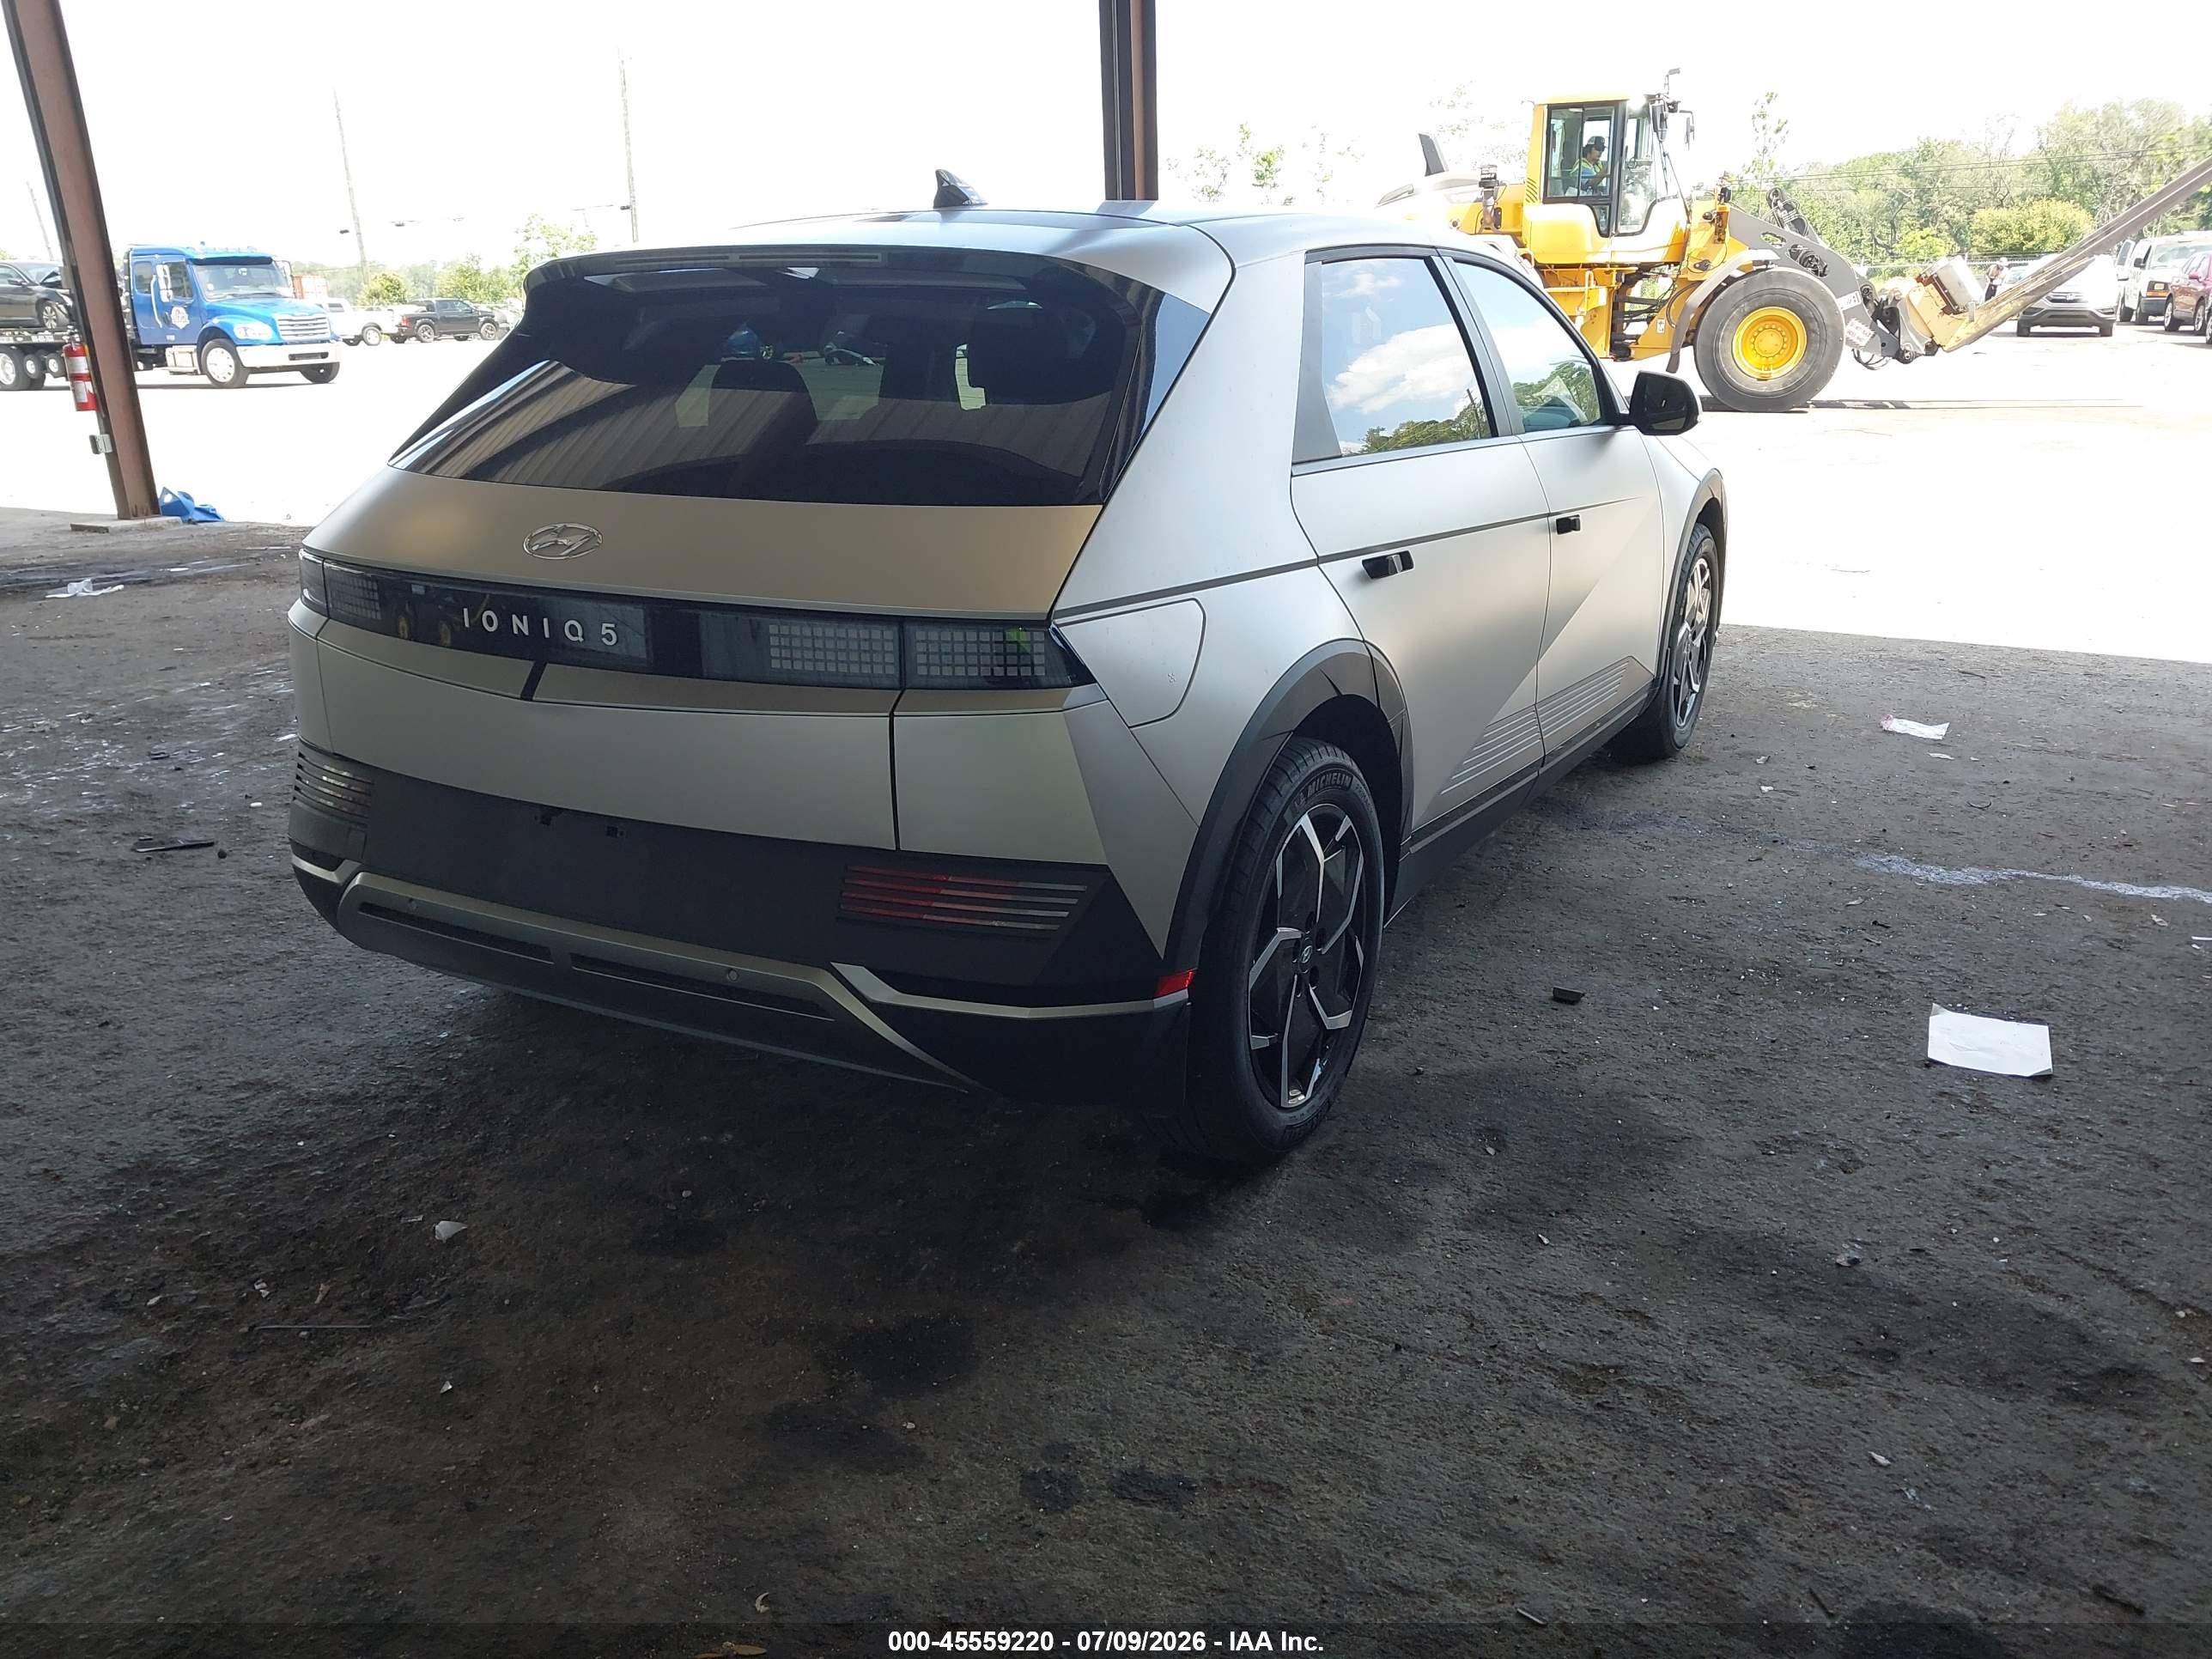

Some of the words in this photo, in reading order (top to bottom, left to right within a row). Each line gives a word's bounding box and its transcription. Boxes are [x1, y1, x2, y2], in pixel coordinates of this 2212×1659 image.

[463, 608, 584, 642] IONIQ
[601, 623, 618, 646] 5
[1307, 772, 1352, 797] MICHELIN
